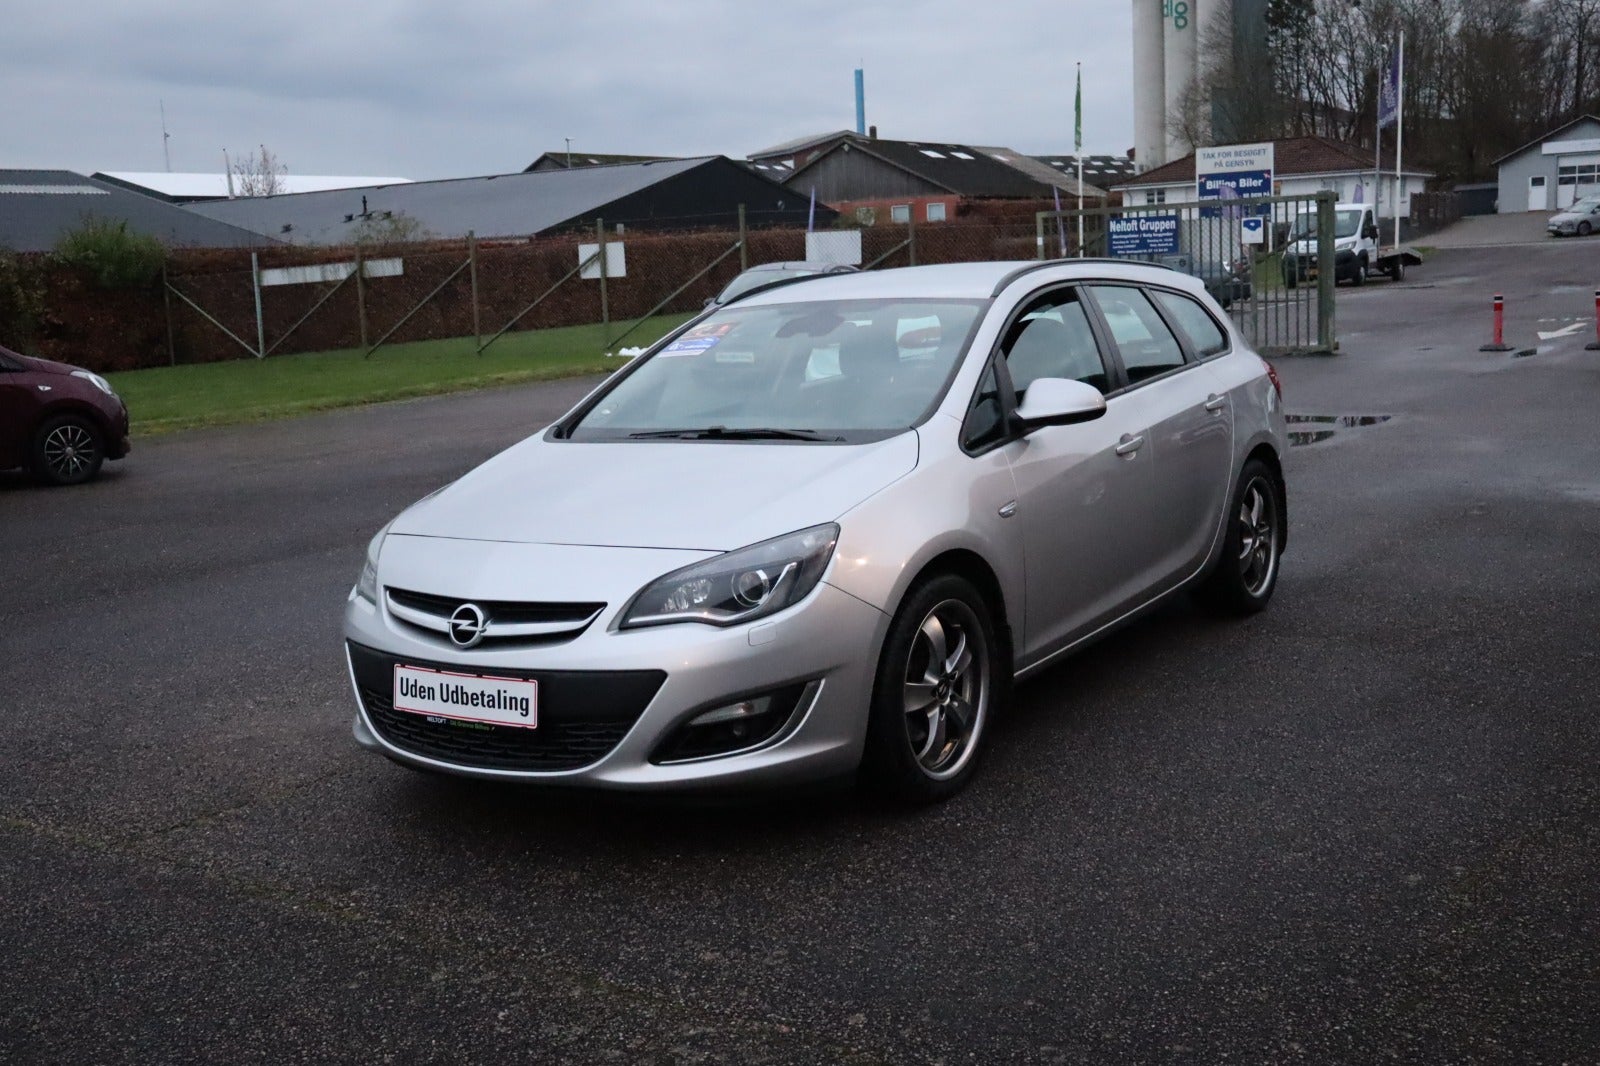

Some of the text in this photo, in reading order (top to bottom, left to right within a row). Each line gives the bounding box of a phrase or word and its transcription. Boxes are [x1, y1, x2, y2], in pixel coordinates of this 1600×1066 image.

[1162, 0, 1188, 29] dlg
[1202, 152, 1216, 160] TAK
[1217, 151, 1232, 159] FOR
[1214, 159, 1255, 168] PÅ GENSYN
[1239, 177, 1263, 188] Biler
[1109, 218, 1176, 233] Neltoft Gruppen
[400, 676, 530, 718] Uden Udbetaling
